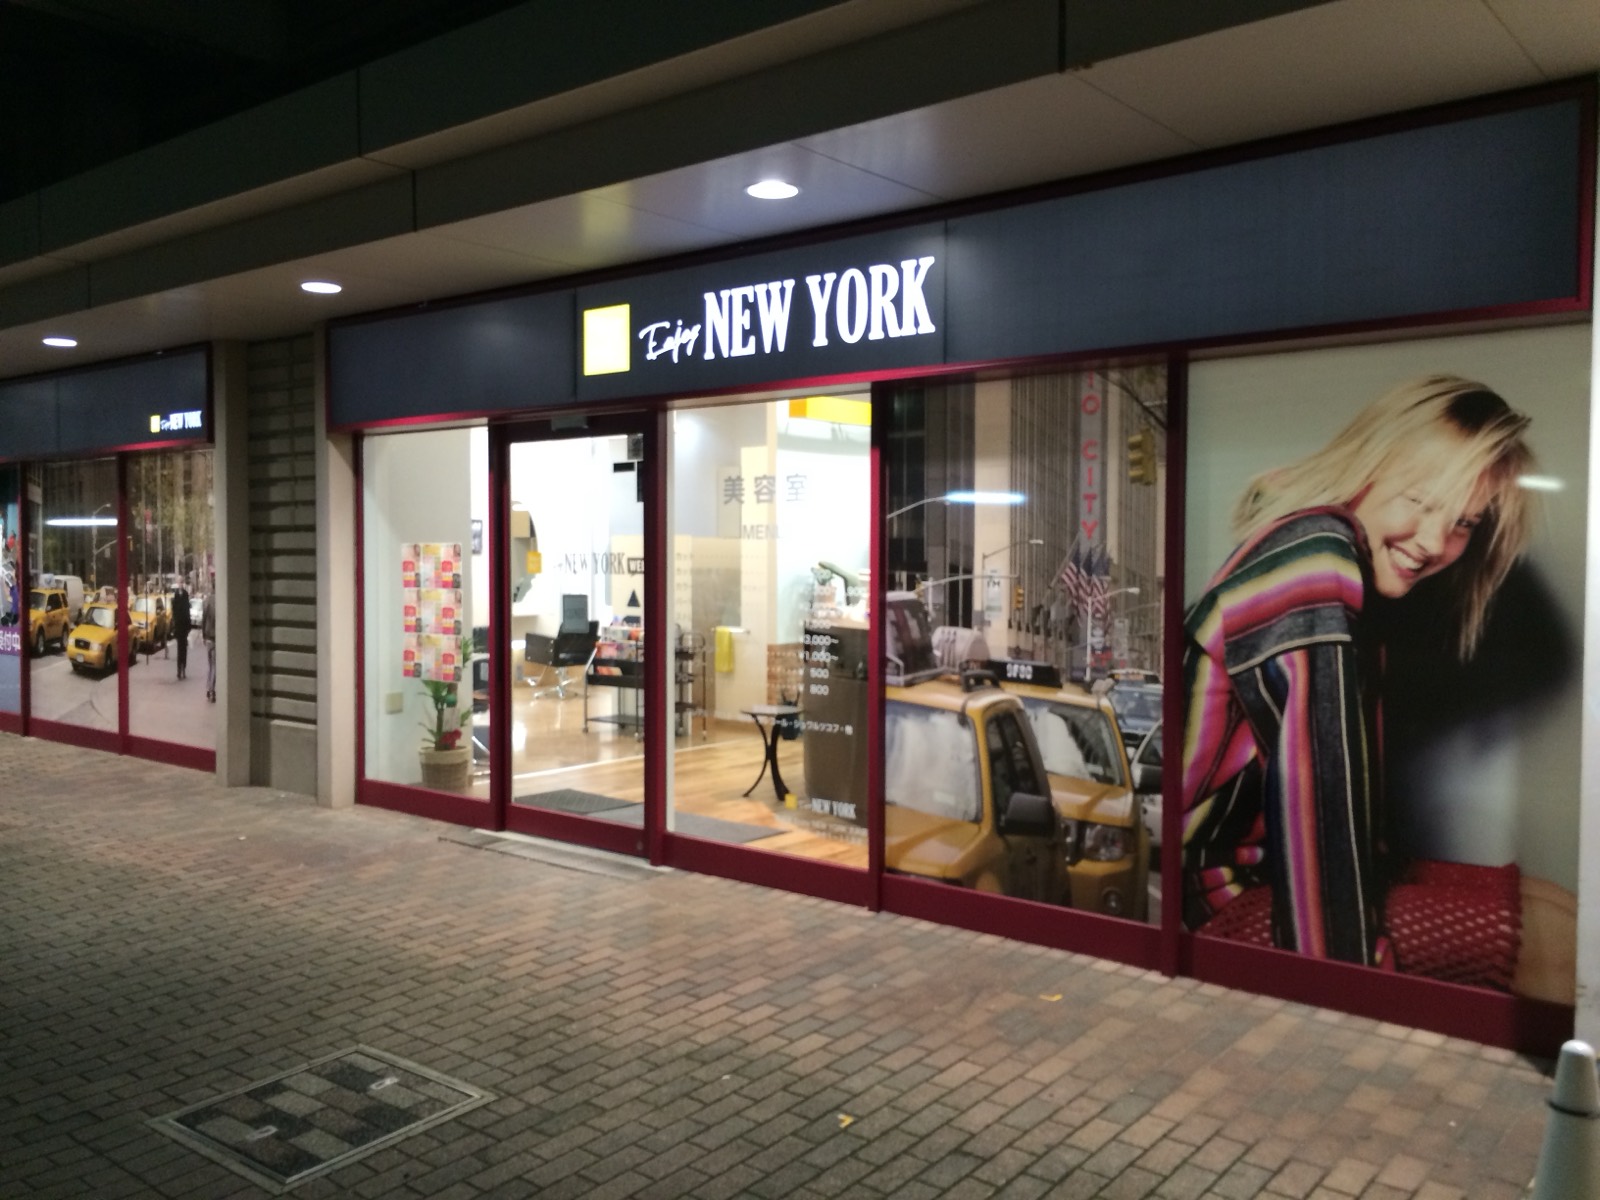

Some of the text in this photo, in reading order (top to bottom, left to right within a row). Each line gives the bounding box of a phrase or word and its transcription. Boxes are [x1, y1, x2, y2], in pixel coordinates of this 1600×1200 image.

[638, 256, 936, 363] Enjoy NEW YORK
[723, 473, 808, 505] 美容室
[1080, 439, 1100, 540] CITY
[592, 551, 626, 575] YORK
